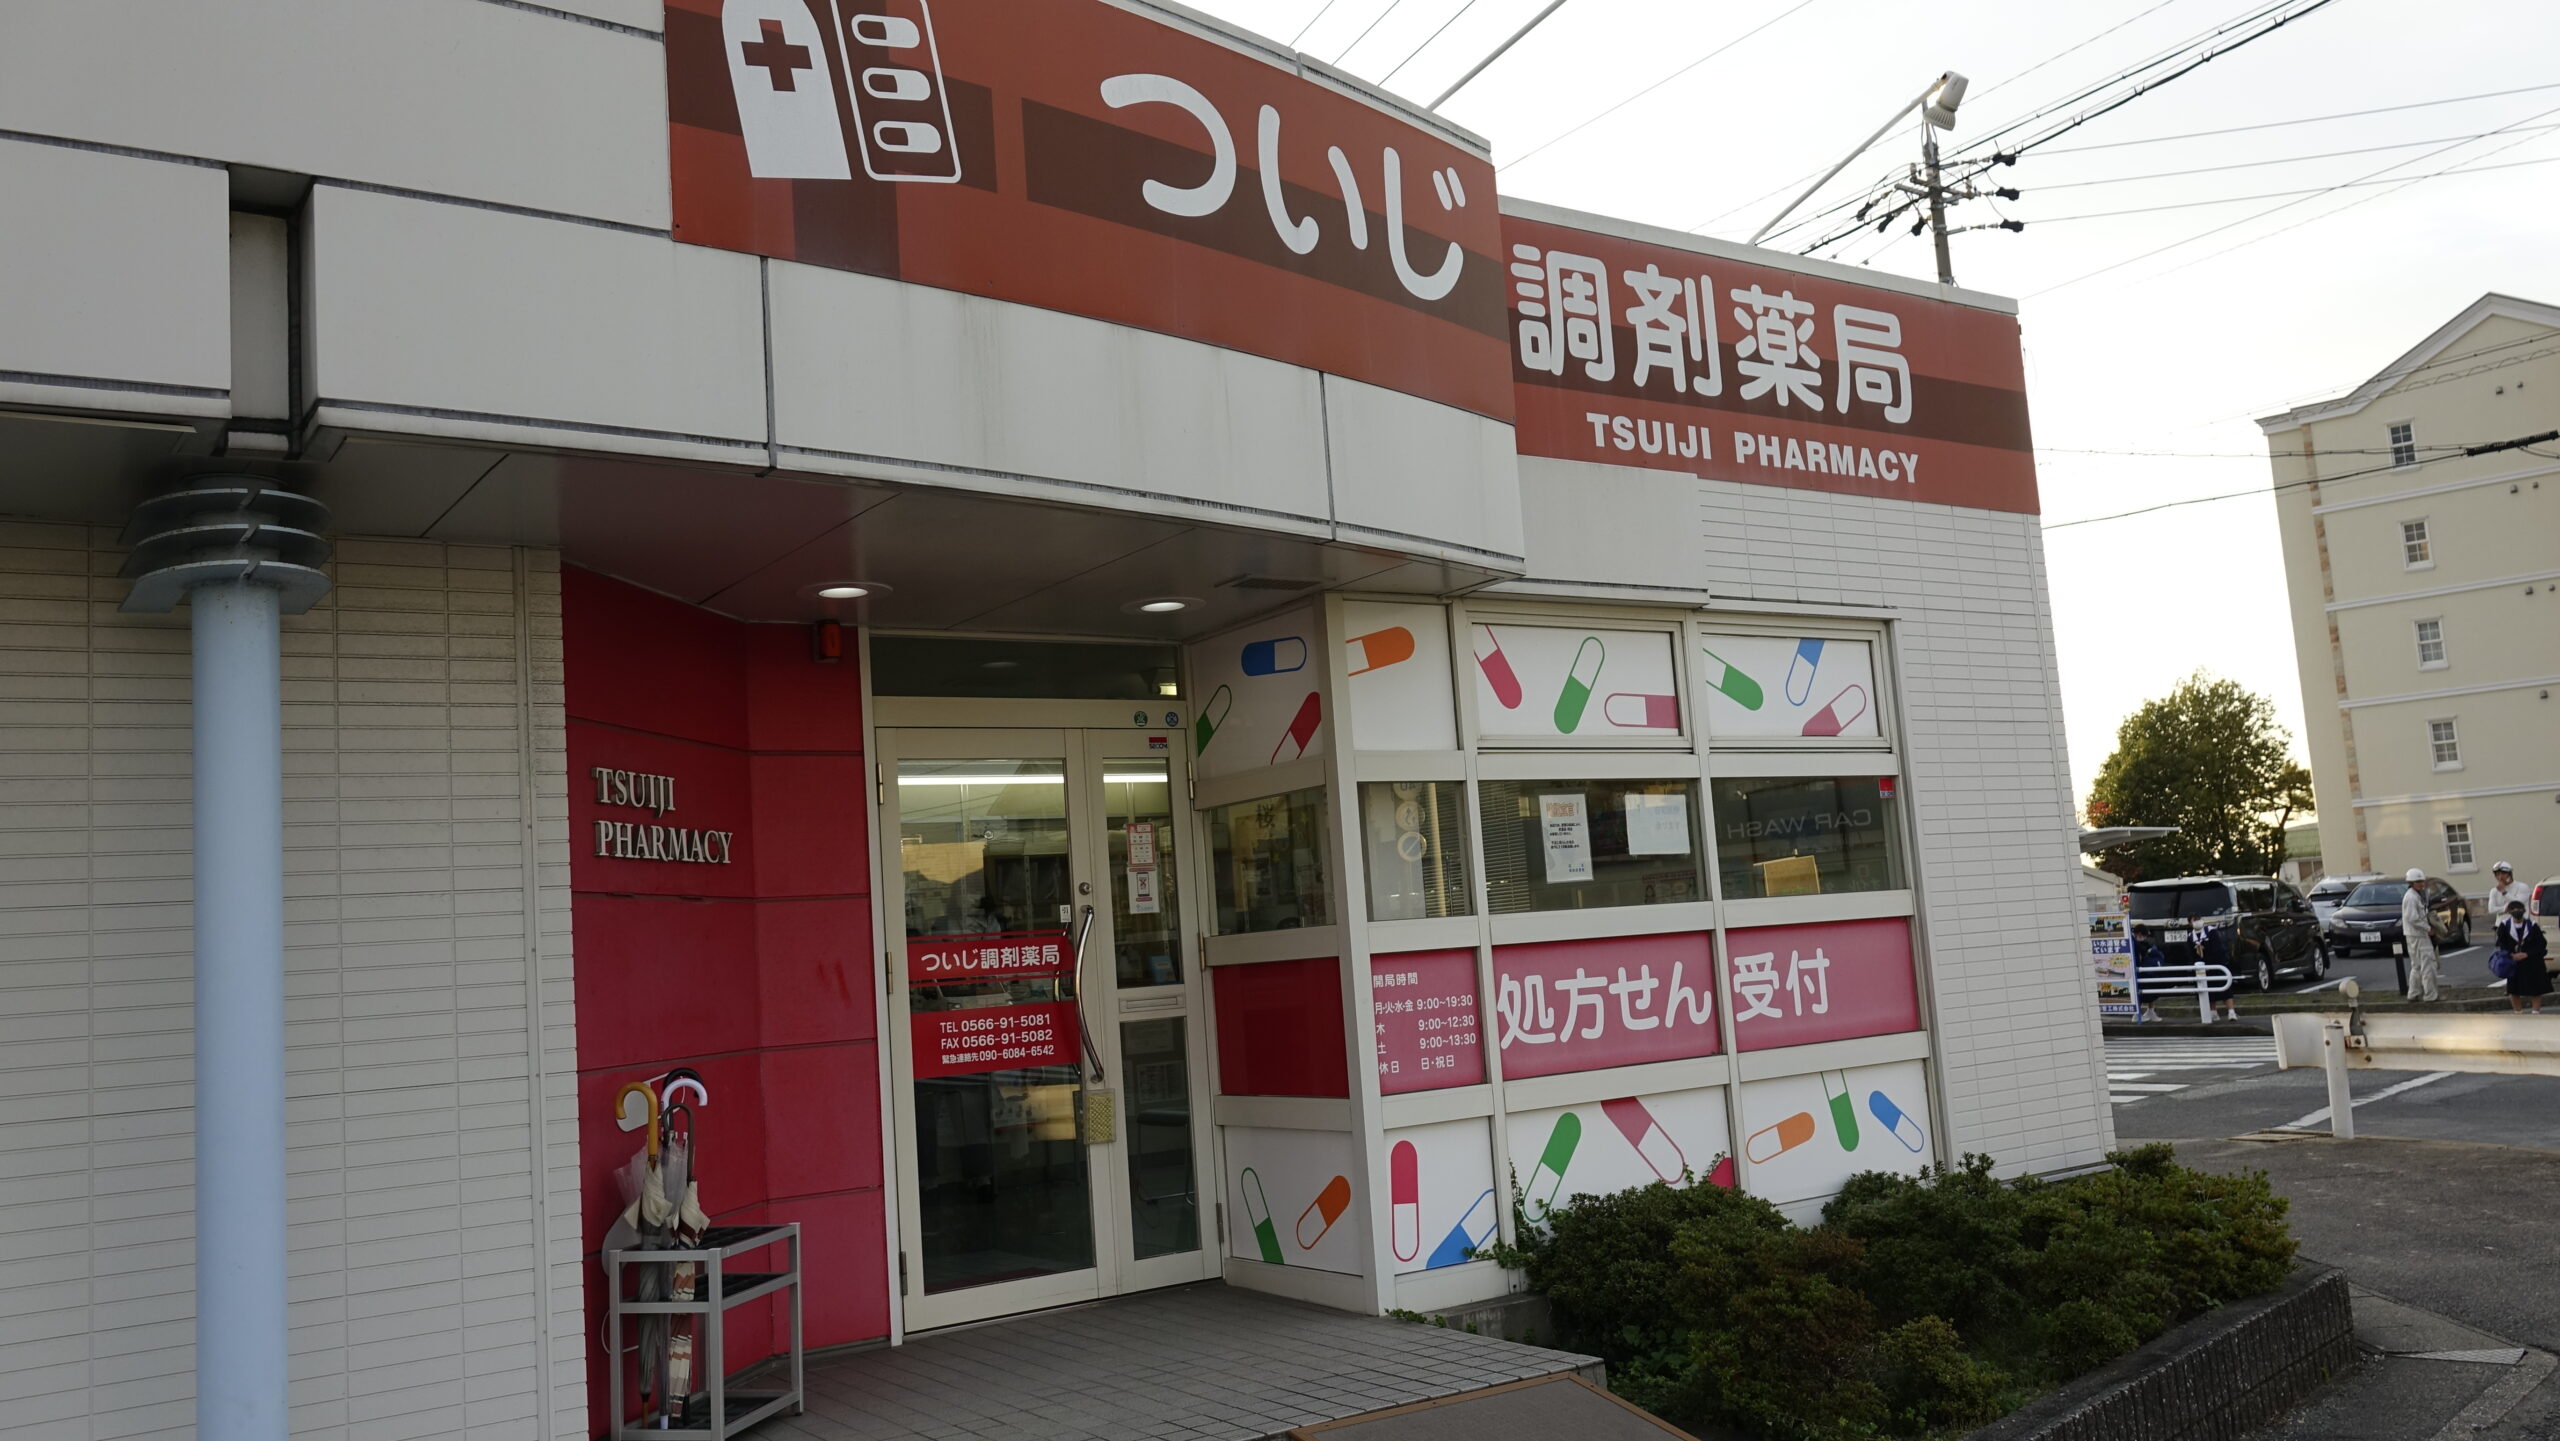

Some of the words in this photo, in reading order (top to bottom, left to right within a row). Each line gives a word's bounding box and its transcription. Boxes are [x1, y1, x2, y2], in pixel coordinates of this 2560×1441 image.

[1100, 73, 1466, 301] ついじ
[1510, 243, 1913, 424] 調剤薬局
[1586, 412, 1712, 460] TSUIJI
[1734, 431, 1919, 484] PHARMACY
[594, 766, 676, 818] TSUIJI
[594, 819, 733, 864] PHARMACY
[921, 944, 1060, 972] ついじ調剤薬局
[1373, 972, 1418, 988] 開局時間
[1497, 961, 1712, 1050] 処方せん
[1733, 947, 1830, 1023] 受付
[2100, 1004, 2135, 1012] 管工株式会社
[940, 1022, 959, 1034] TEL
[961, 1013, 1051, 1032] 0566-91-5081
[1376, 1022, 1386, 1036] 木
[941, 1037, 960, 1050] FAX
[962, 1029, 1053, 1048] 0566-91-5082
[1377, 1041, 1387, 1055] 土
